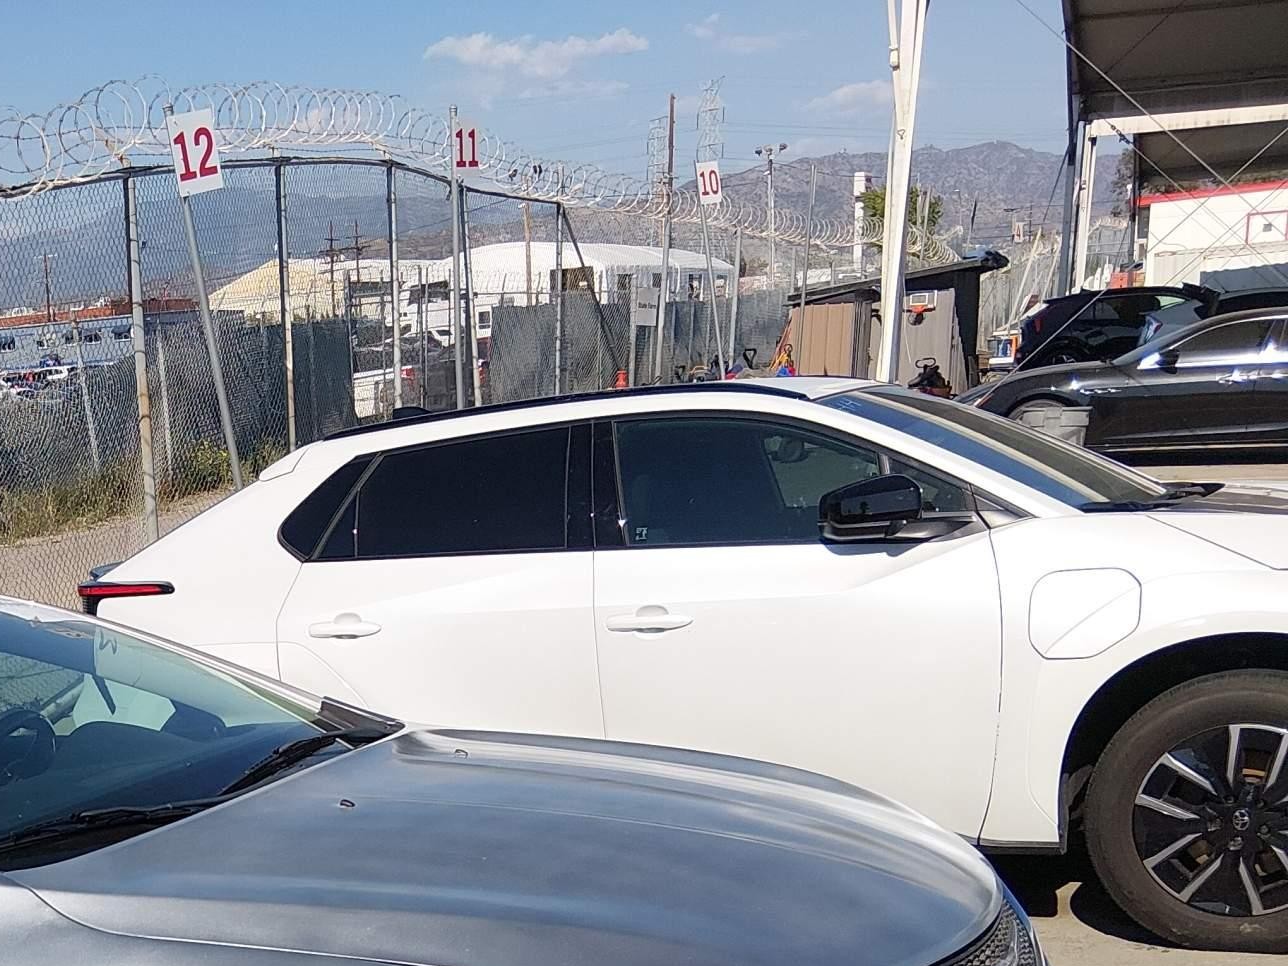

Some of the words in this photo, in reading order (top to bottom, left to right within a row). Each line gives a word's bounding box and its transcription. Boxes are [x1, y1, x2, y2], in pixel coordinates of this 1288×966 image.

[173, 127, 218, 181] 12
[455, 128, 479, 167] 11
[699, 170, 719, 195] 10
